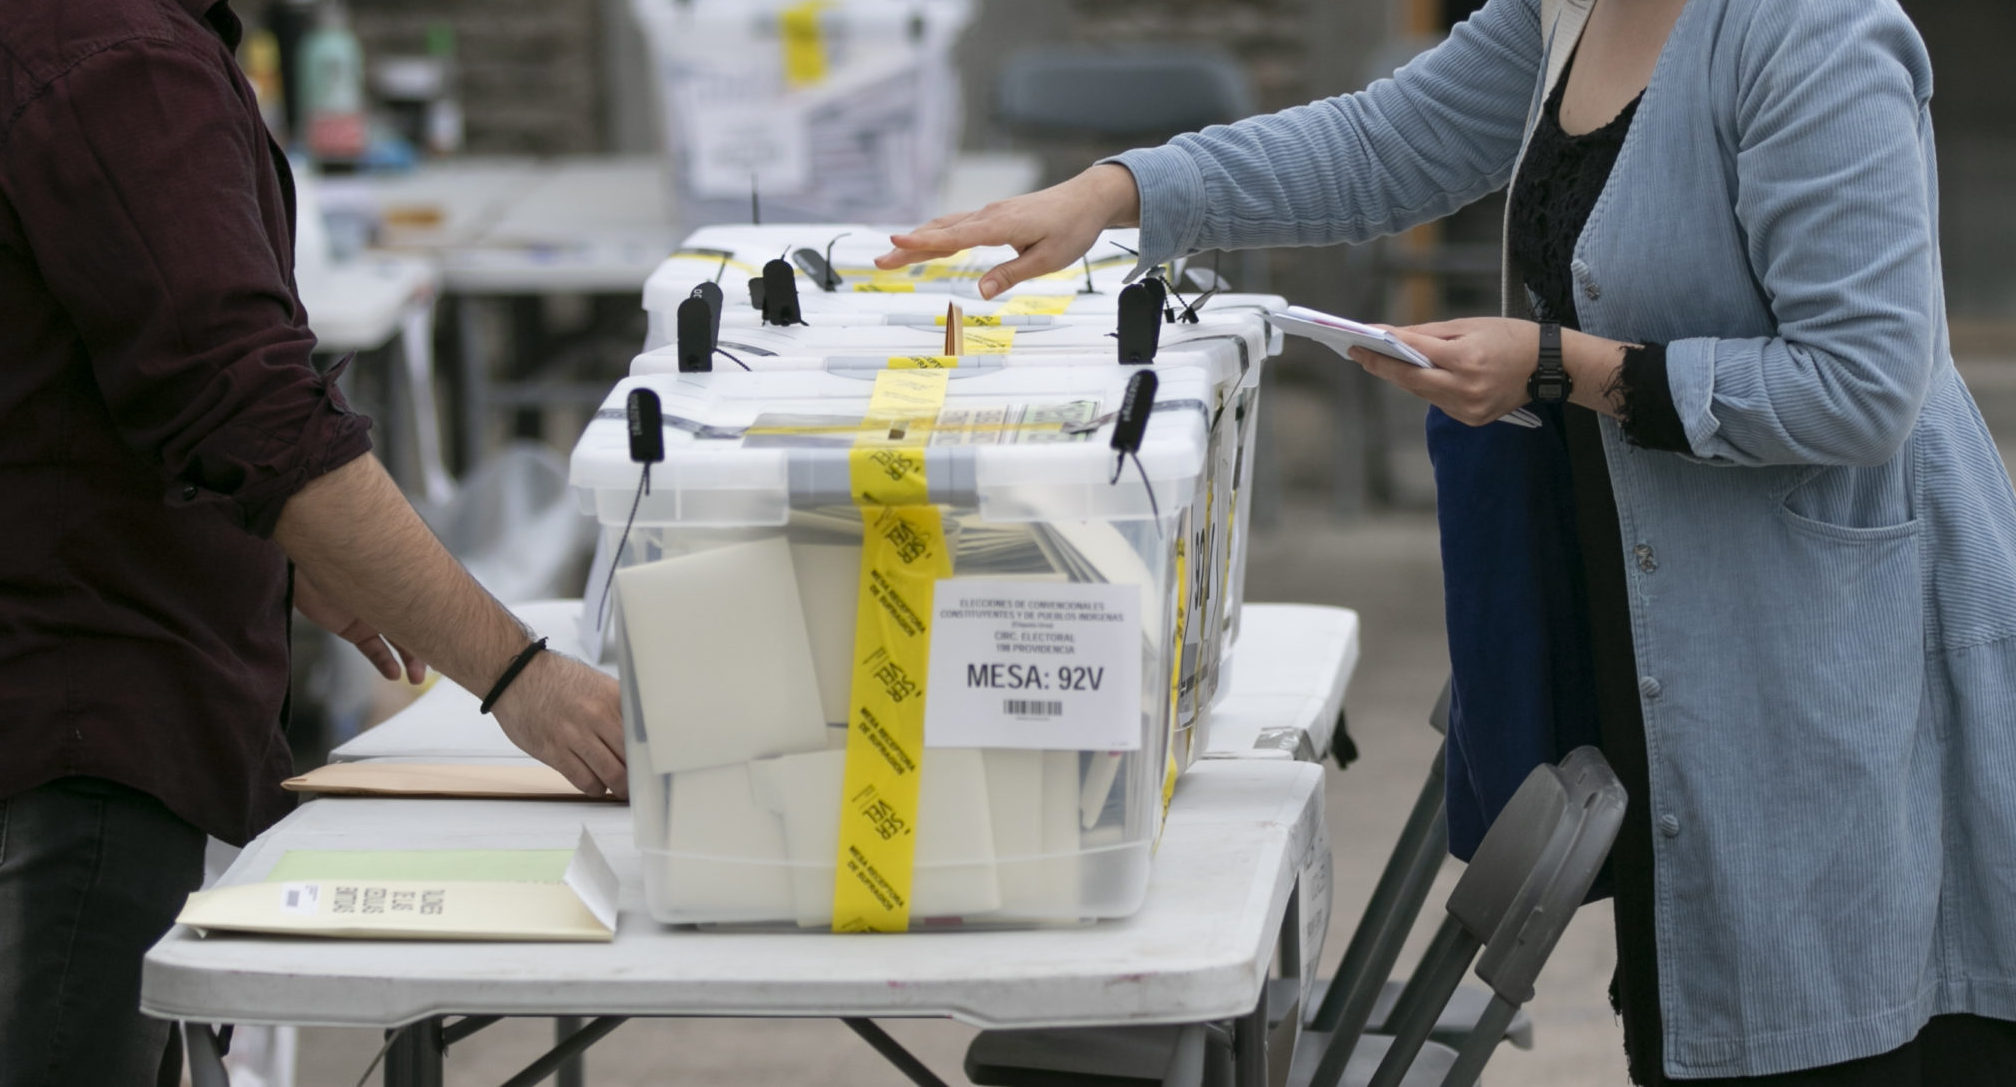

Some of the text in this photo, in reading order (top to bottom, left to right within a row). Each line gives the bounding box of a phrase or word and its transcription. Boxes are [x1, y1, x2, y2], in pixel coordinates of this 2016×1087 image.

[1014, 600, 1024, 609] DE
[1021, 632, 1075, 643] ELECTORAL
[1013, 643, 1075, 654] PROVIDENCIA
[967, 663, 1104, 691] MESA: 92V
[875, 812, 905, 840] SER
